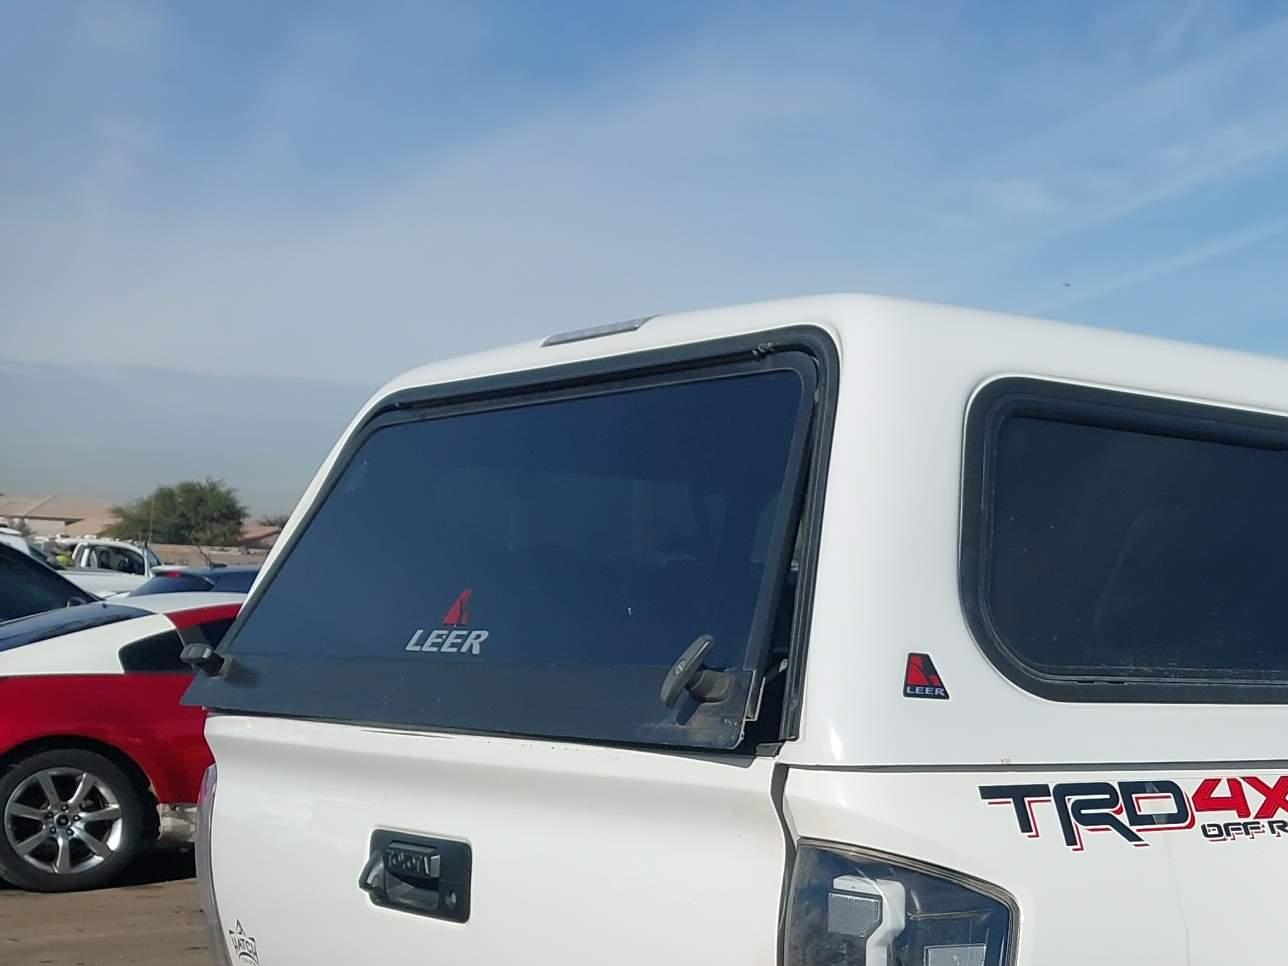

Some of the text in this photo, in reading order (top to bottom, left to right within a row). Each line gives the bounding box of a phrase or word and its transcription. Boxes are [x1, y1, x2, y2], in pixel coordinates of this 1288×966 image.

[405, 629, 489, 655] LEER
[906, 686, 945, 696] LEER
[978, 780, 1195, 851] TRD
[1200, 820, 1265, 841] OFF
